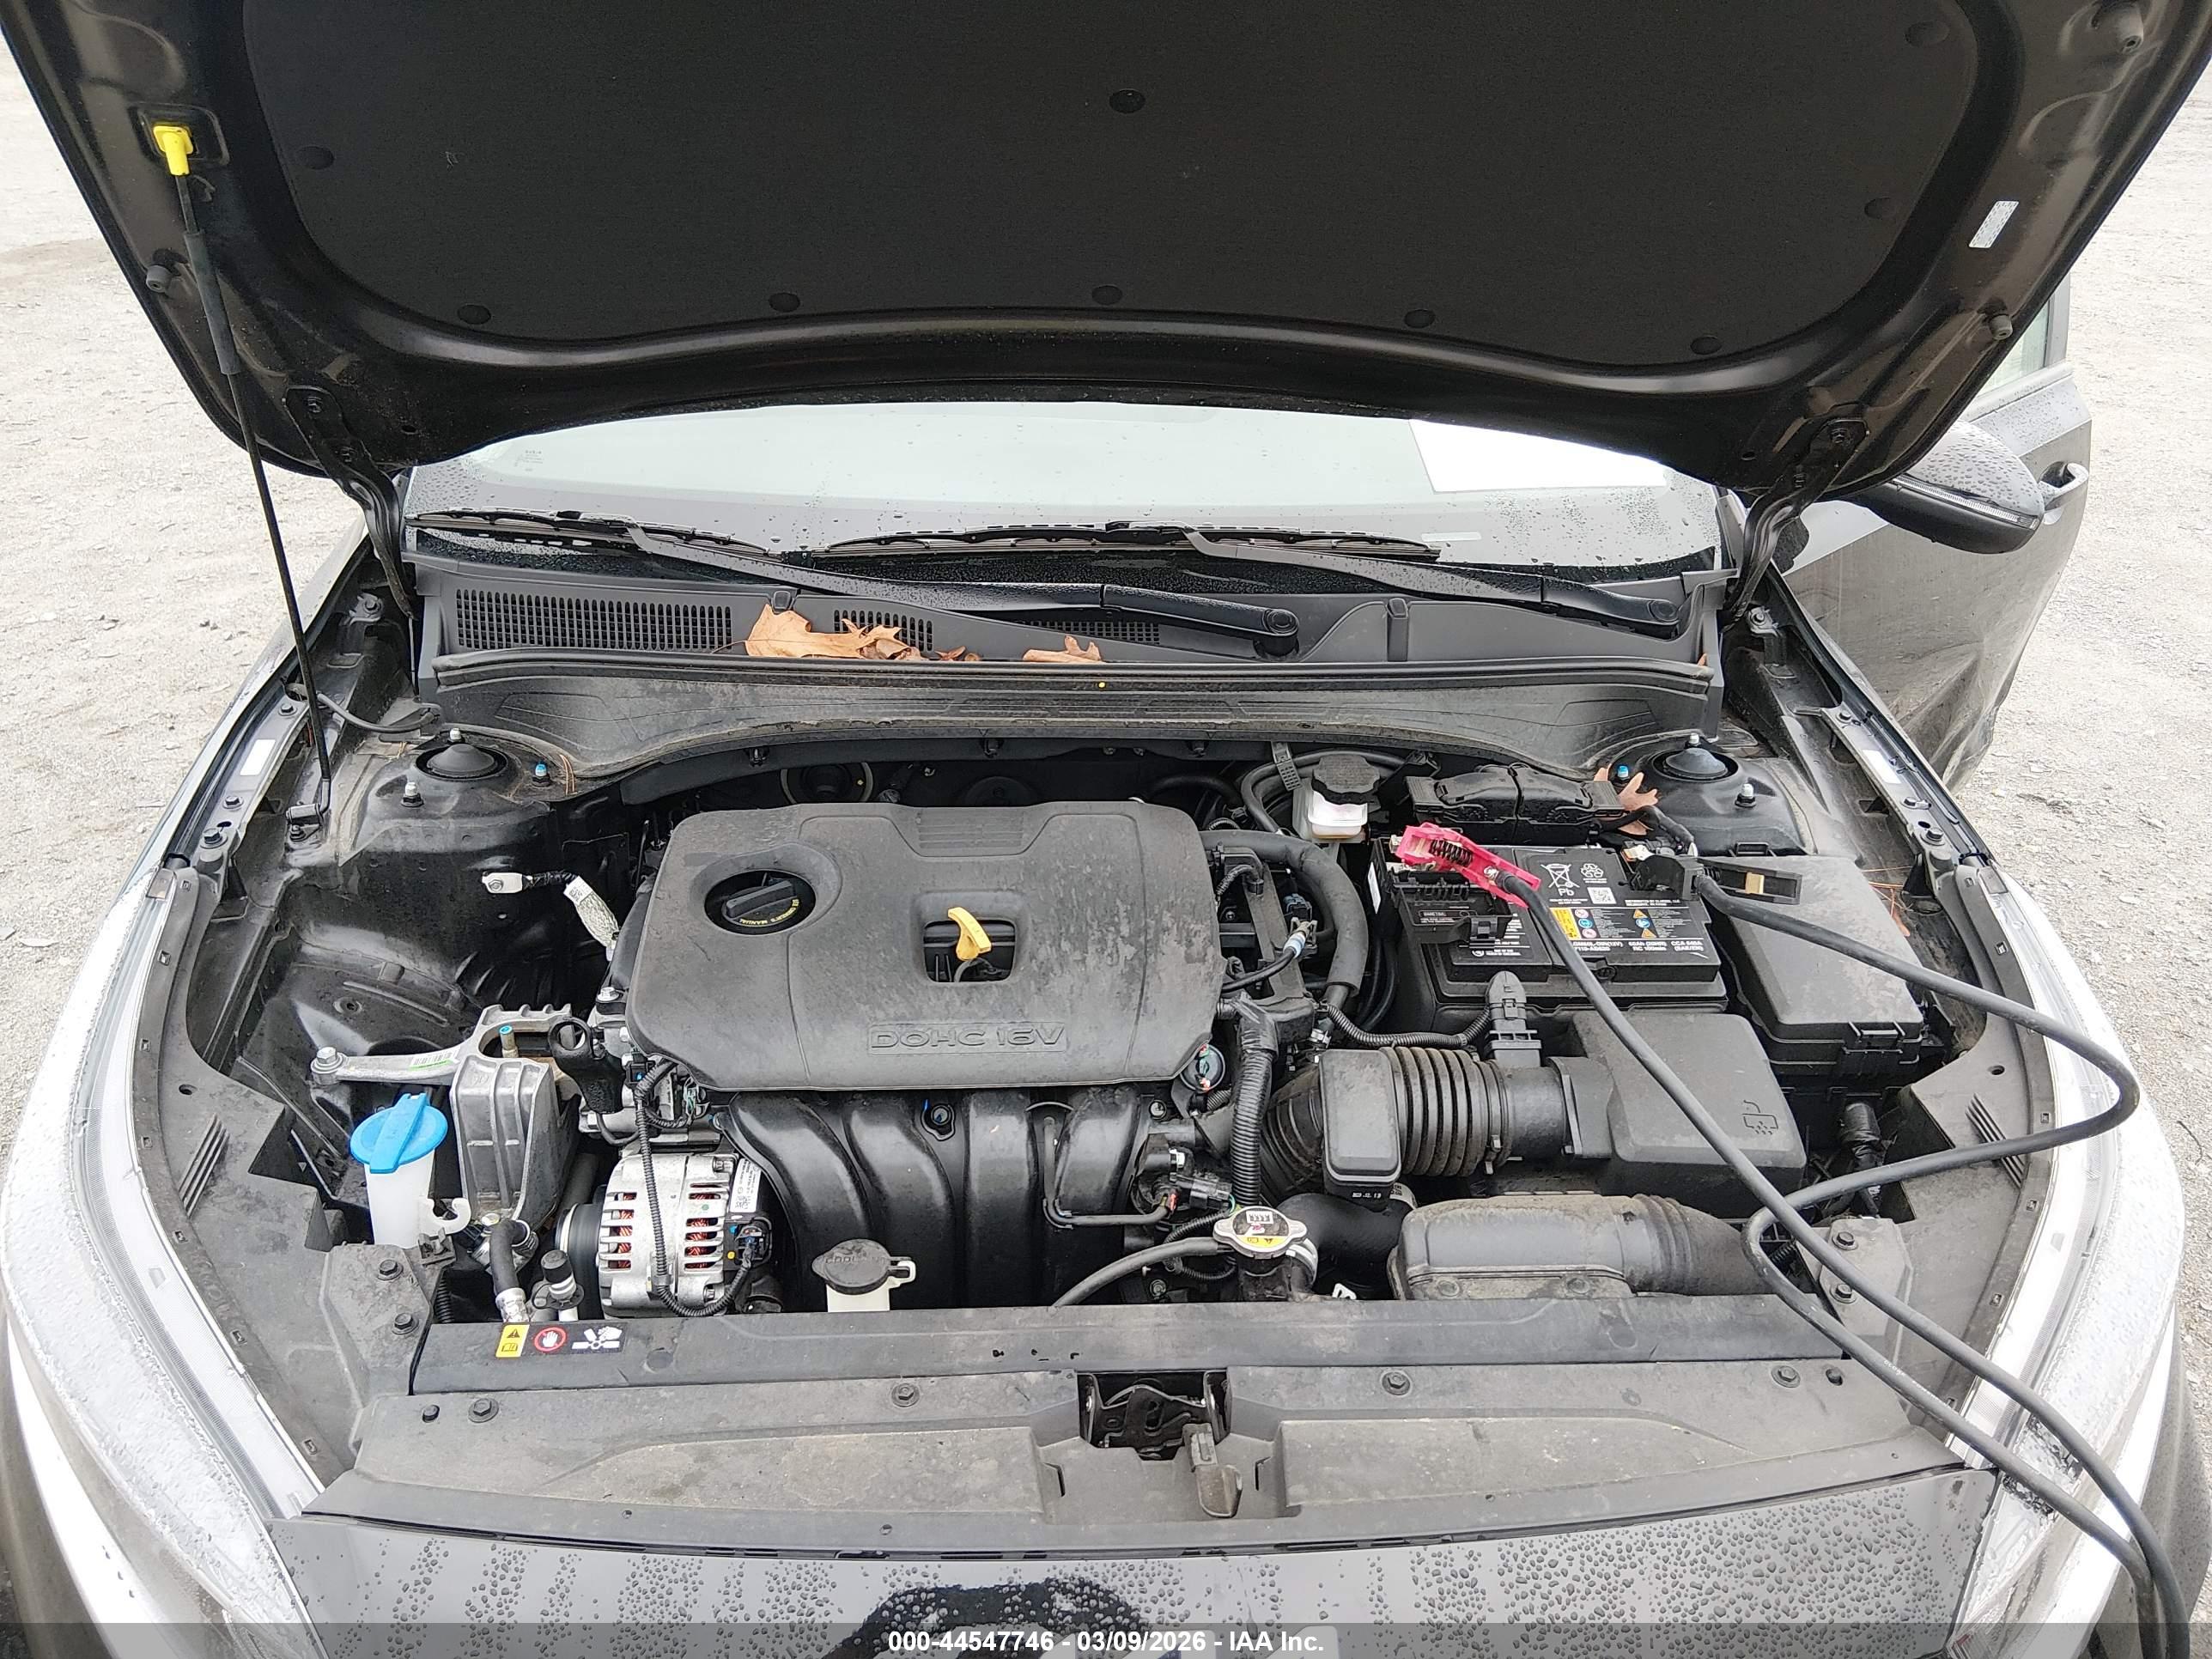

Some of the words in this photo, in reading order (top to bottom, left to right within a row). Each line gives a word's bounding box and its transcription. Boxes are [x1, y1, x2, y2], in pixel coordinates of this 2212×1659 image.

[1558, 888, 1575, 896] Pb
[871, 1029, 986, 1048] DOHC
[996, 1025, 1066, 1046] 16V
